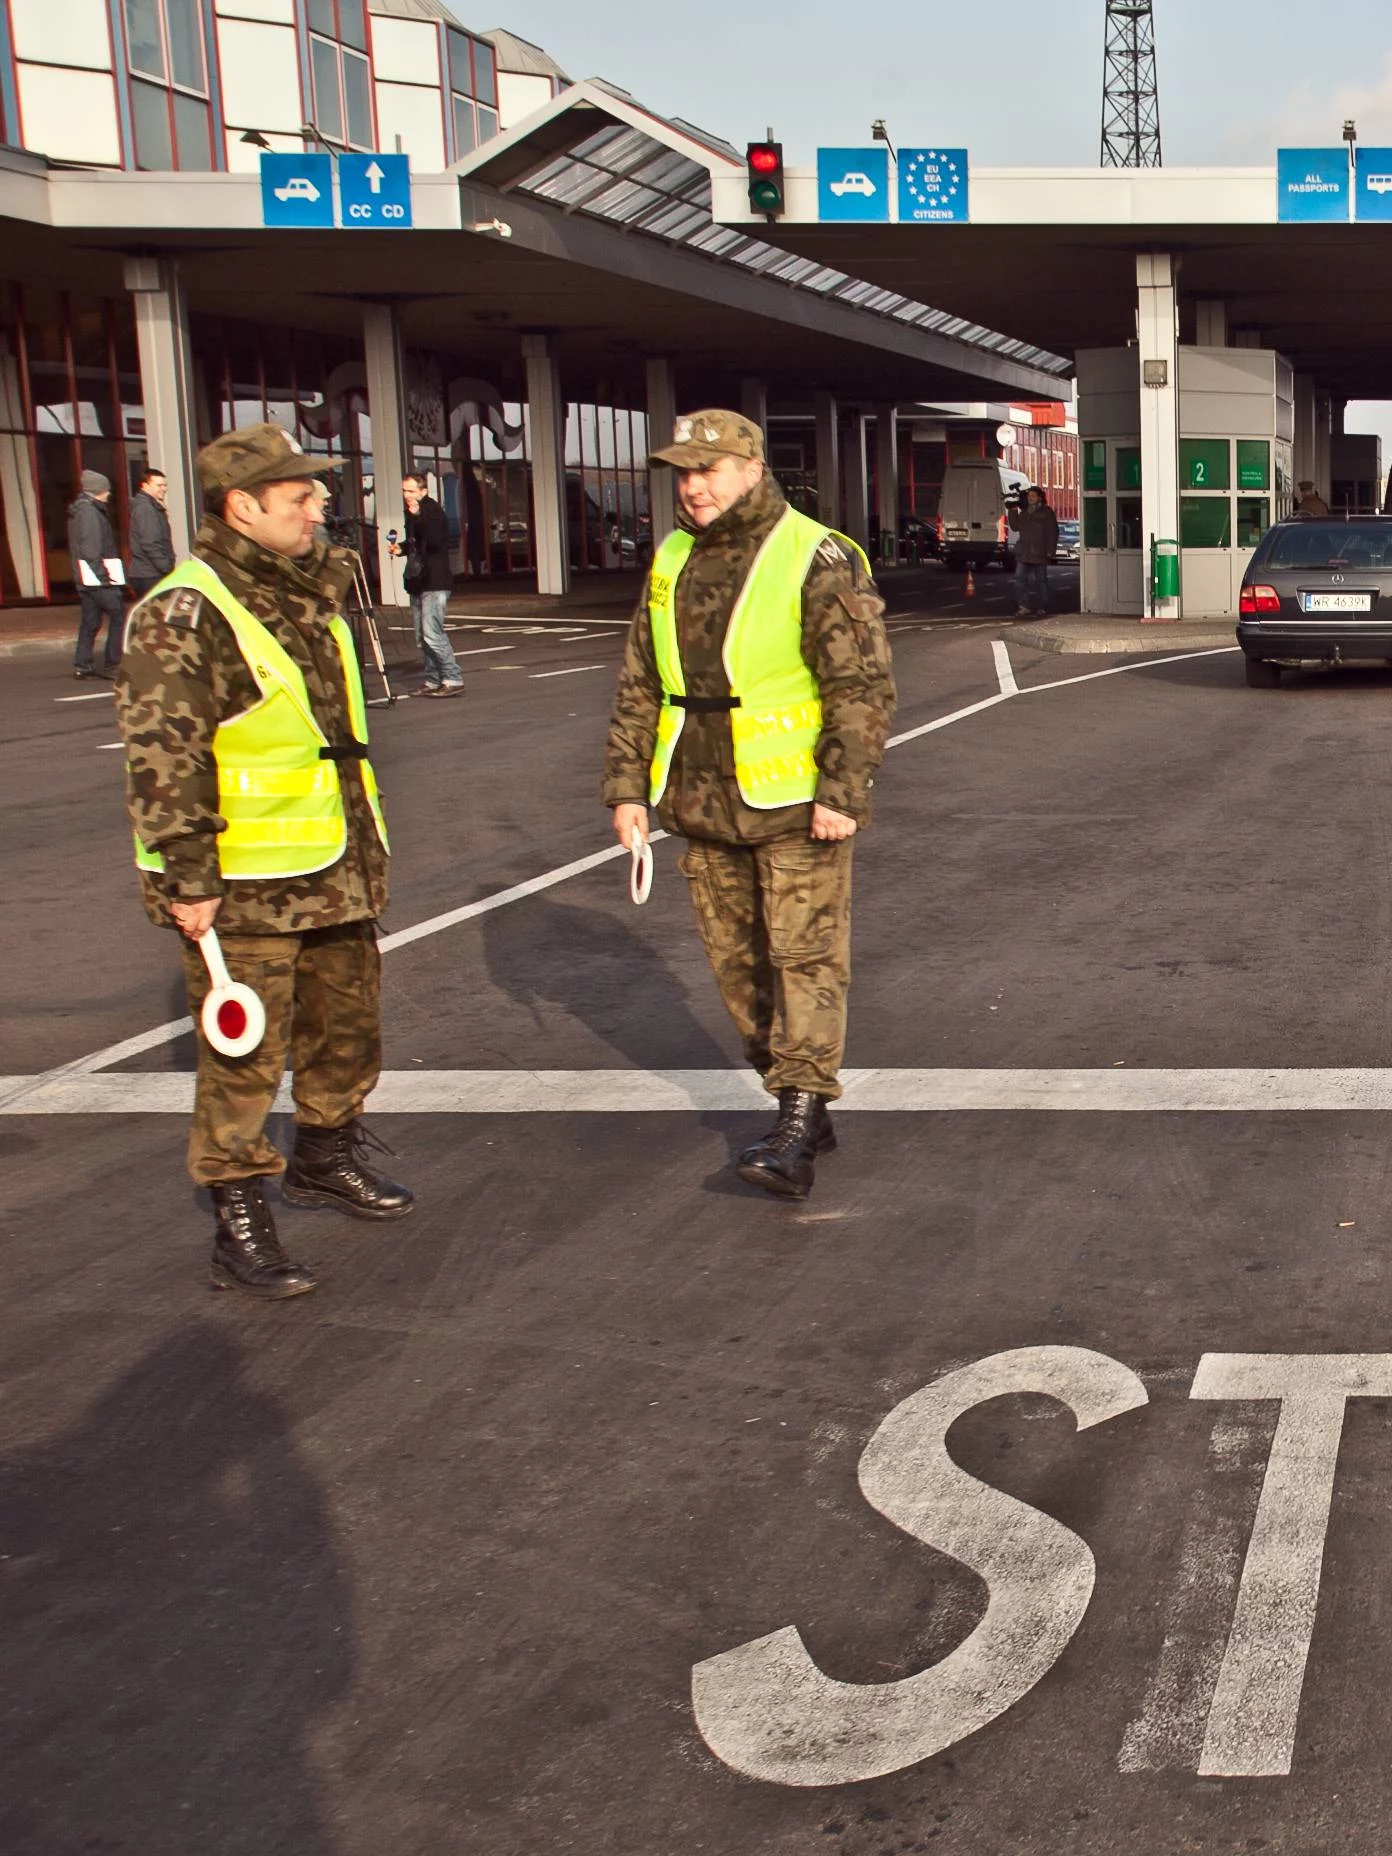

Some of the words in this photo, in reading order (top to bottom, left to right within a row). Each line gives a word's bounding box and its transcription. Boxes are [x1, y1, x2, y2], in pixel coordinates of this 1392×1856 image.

[926, 165, 939, 174] EU
[924, 174, 942, 183] EEA
[1305, 174, 1322, 184] ALL
[926, 184, 939, 192] CH
[1288, 184, 1340, 193] PASSPORTS
[350, 204, 372, 218] CC
[381, 205, 405, 218] CD
[913, 210, 954, 219] CITIZENS
[1196, 462, 1205, 482] 2
[1313, 596, 1330, 607] WR
[1333, 597, 1368, 607] 4639K
